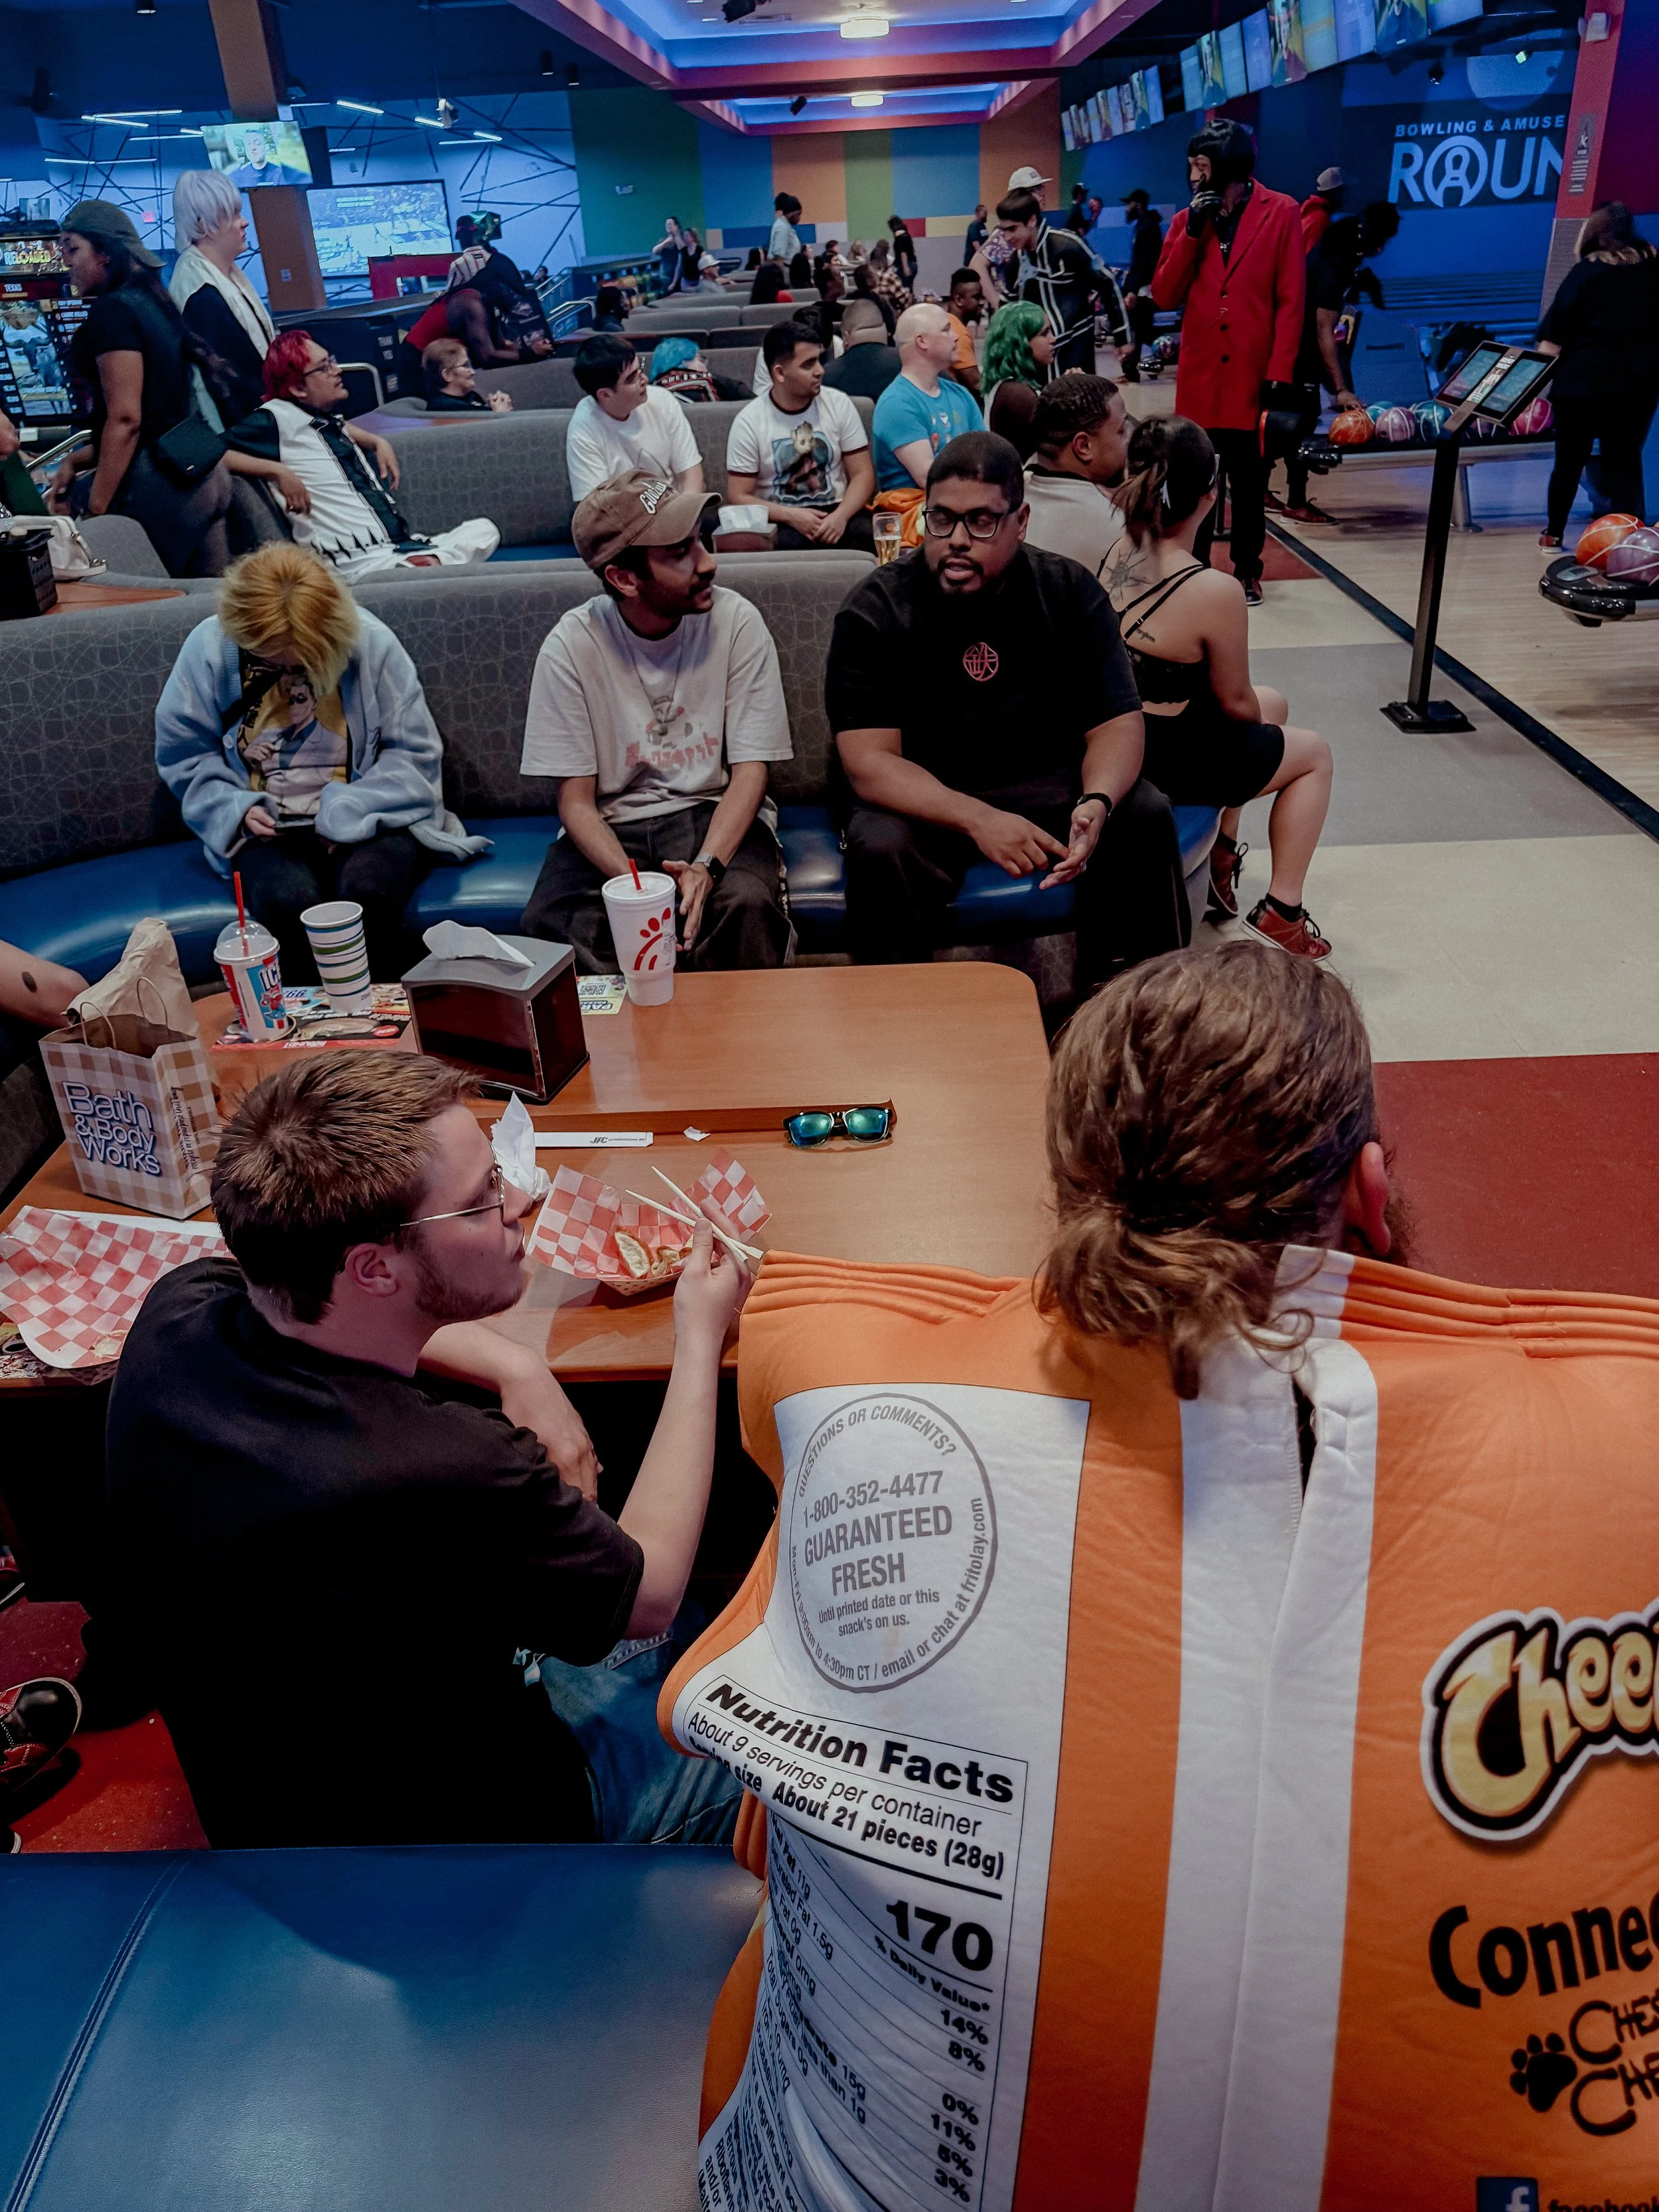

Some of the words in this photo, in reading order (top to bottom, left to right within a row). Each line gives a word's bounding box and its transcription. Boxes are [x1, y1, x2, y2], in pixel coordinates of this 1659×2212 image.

[1394, 121, 1477, 137] BOWLING
[1483, 119, 1494, 132] &
[1500, 115, 1564, 131] AMUSE
[62, 1081, 153, 1129] Bath
[74, 1114, 94, 1137] &
[94, 1117, 155, 1154] Body
[76, 1134, 162, 1176] Works
[798, 1418, 844, 1497] QUESTIONS
[848, 1408, 867, 1426] OR
[871, 1405, 956, 1456] COMMENTS?
[803, 1471, 944, 1528] 1-800-352-4477
[804, 1505, 952, 1566] GUARANTEED
[960, 1497, 989, 1593] fritolay.com
[831, 1552, 906, 1596] FRESH
[819, 1607, 835, 1624] Until
[837, 1597, 869, 1620] printed
[871, 1593, 896, 1609] date
[899, 1593, 912, 1605] or
[915, 1587, 940, 1605] this
[958, 1594, 969, 1614] at
[838, 1616, 873, 1637] snack's
[875, 1615, 890, 1628] on
[893, 1613, 910, 1627] us.
[931, 1611, 961, 1643] chat
[815, 1641, 823, 1660] to
[824, 1652, 855, 1680] 4:30pm
[881, 1647, 916, 1678] email
[916, 1639, 931, 1657] or
[857, 1664, 871, 1681] CT
[874, 1662, 878, 1680] /
[1442, 1627, 1659, 1817] Chee
[705, 1682, 868, 1767] Nutrition
[878, 1739, 1014, 1805] Facts
[687, 1711, 735, 1747] About
[732, 1736, 749, 1752] 9
[746, 1746, 828, 1792] servings
[827, 1781, 869, 1805] per
[871, 1793, 983, 1838] container
[733, 1762, 763, 1793] size
[771, 1780, 831, 1822] About
[831, 1806, 859, 1832] 21
[861, 1820, 938, 1858] pieces
[944, 1838, 1005, 1880] (28g)
[797, 1869, 812, 1901] 11g
[779, 1893, 791, 1922] Fat
[790, 1917, 802, 1946] 0g
[796, 1898, 811, 1928] Fat
[812, 1921, 834, 1961] 1.5g
[885, 1899, 994, 1972] 170
[795, 1954, 817, 1997] 0mg
[889, 1948, 927, 1986] Daily
[766, 1946, 778, 1992] Total
[774, 1988, 797, 2052] Sugars
[798, 2046, 808, 2077] 0g
[940, 2009, 989, 2045] 14%
[948, 2040, 986, 2073] 8%
[820, 2060, 846, 2102] than
[851, 2097, 867, 2125] 1g
[842, 2065, 867, 2102] 15g
[942, 2093, 979, 2126] 0%
[930, 2113, 976, 2152] 11%
[758, 2095, 786, 2186] significant
[785, 2184, 799, 2212] so
[937, 2142, 974, 2177] 5%
[705, 2155, 722, 2208] and/or
[934, 2168, 970, 2203] 3%
